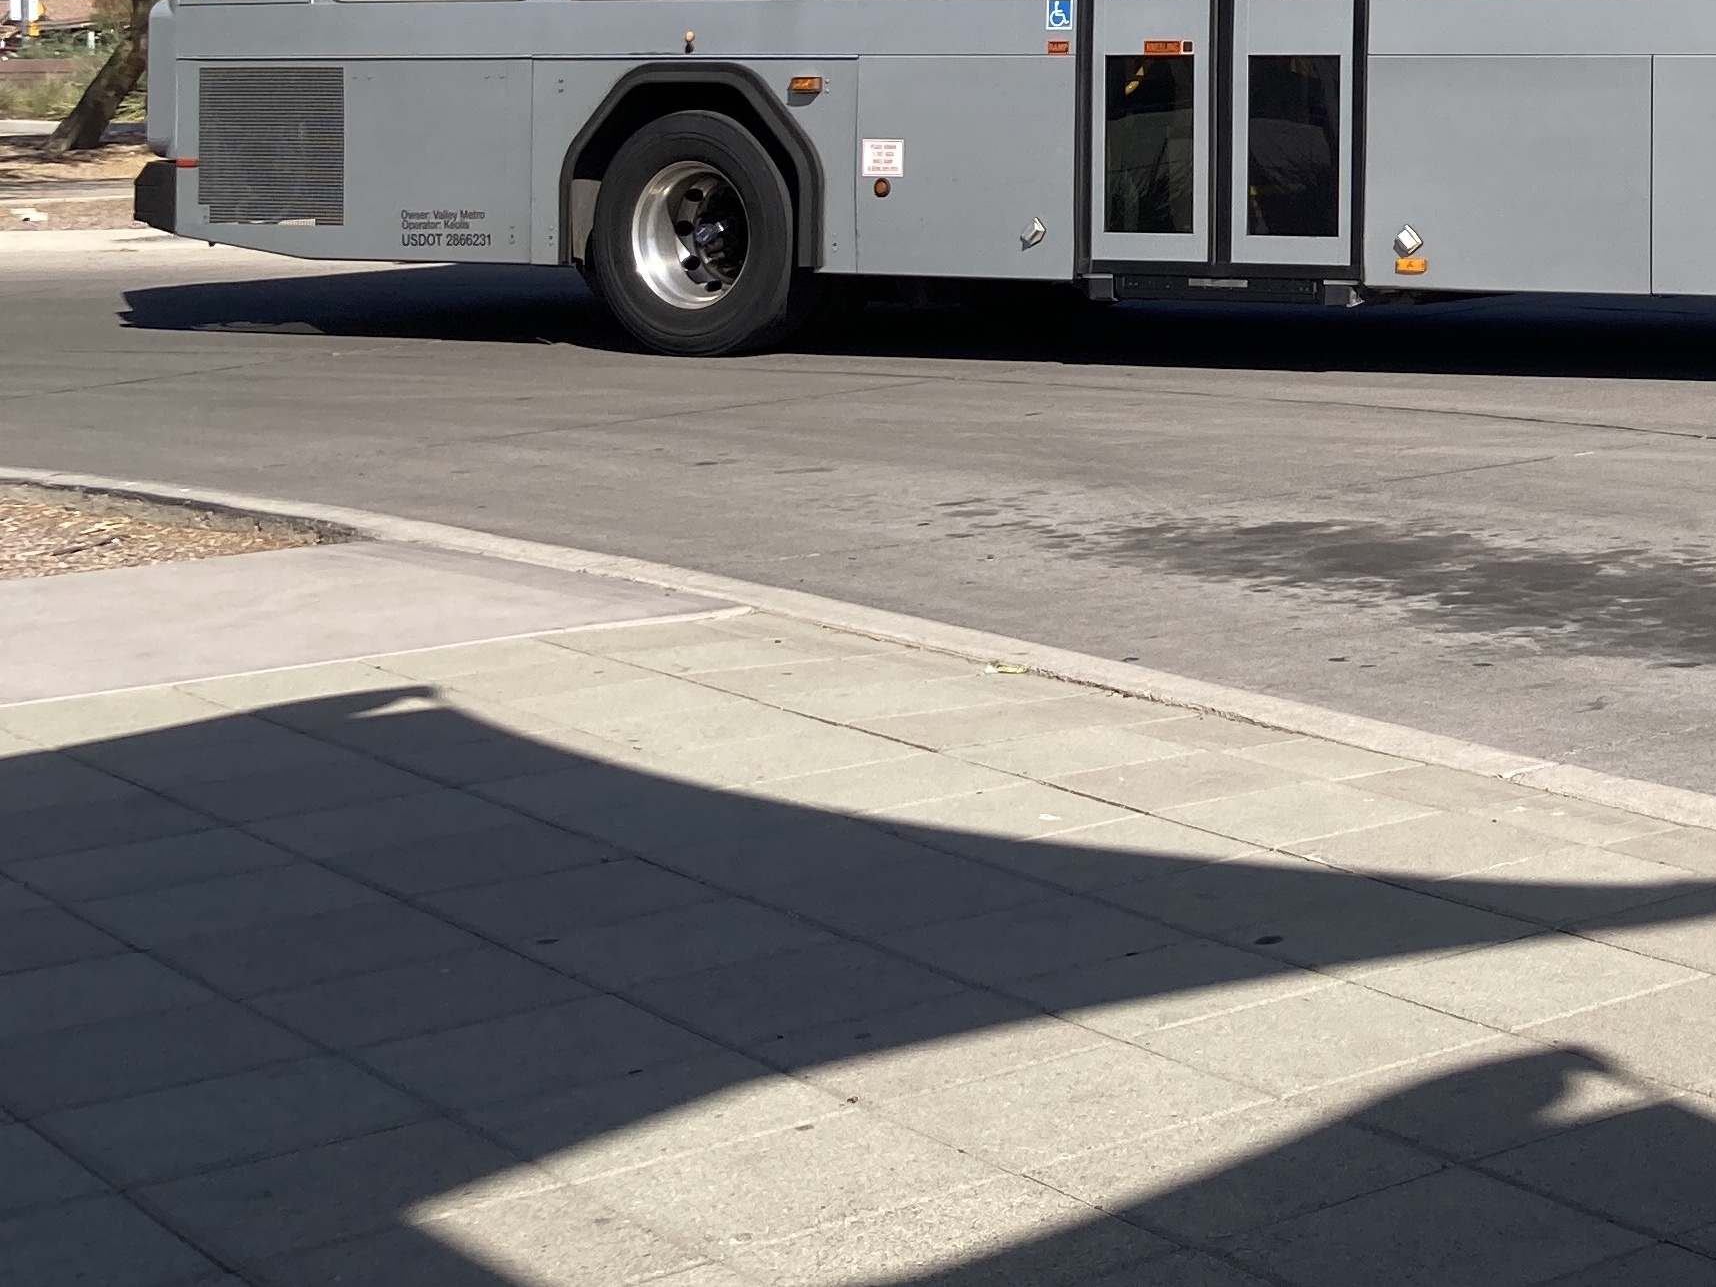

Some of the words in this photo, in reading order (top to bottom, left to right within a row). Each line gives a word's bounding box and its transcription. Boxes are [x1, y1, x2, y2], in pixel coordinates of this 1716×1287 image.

[433, 209, 458, 221] Valley
[460, 209, 485, 219] Metro
[401, 233, 443, 246] USDOT
[446, 233, 492, 246] 2866231
